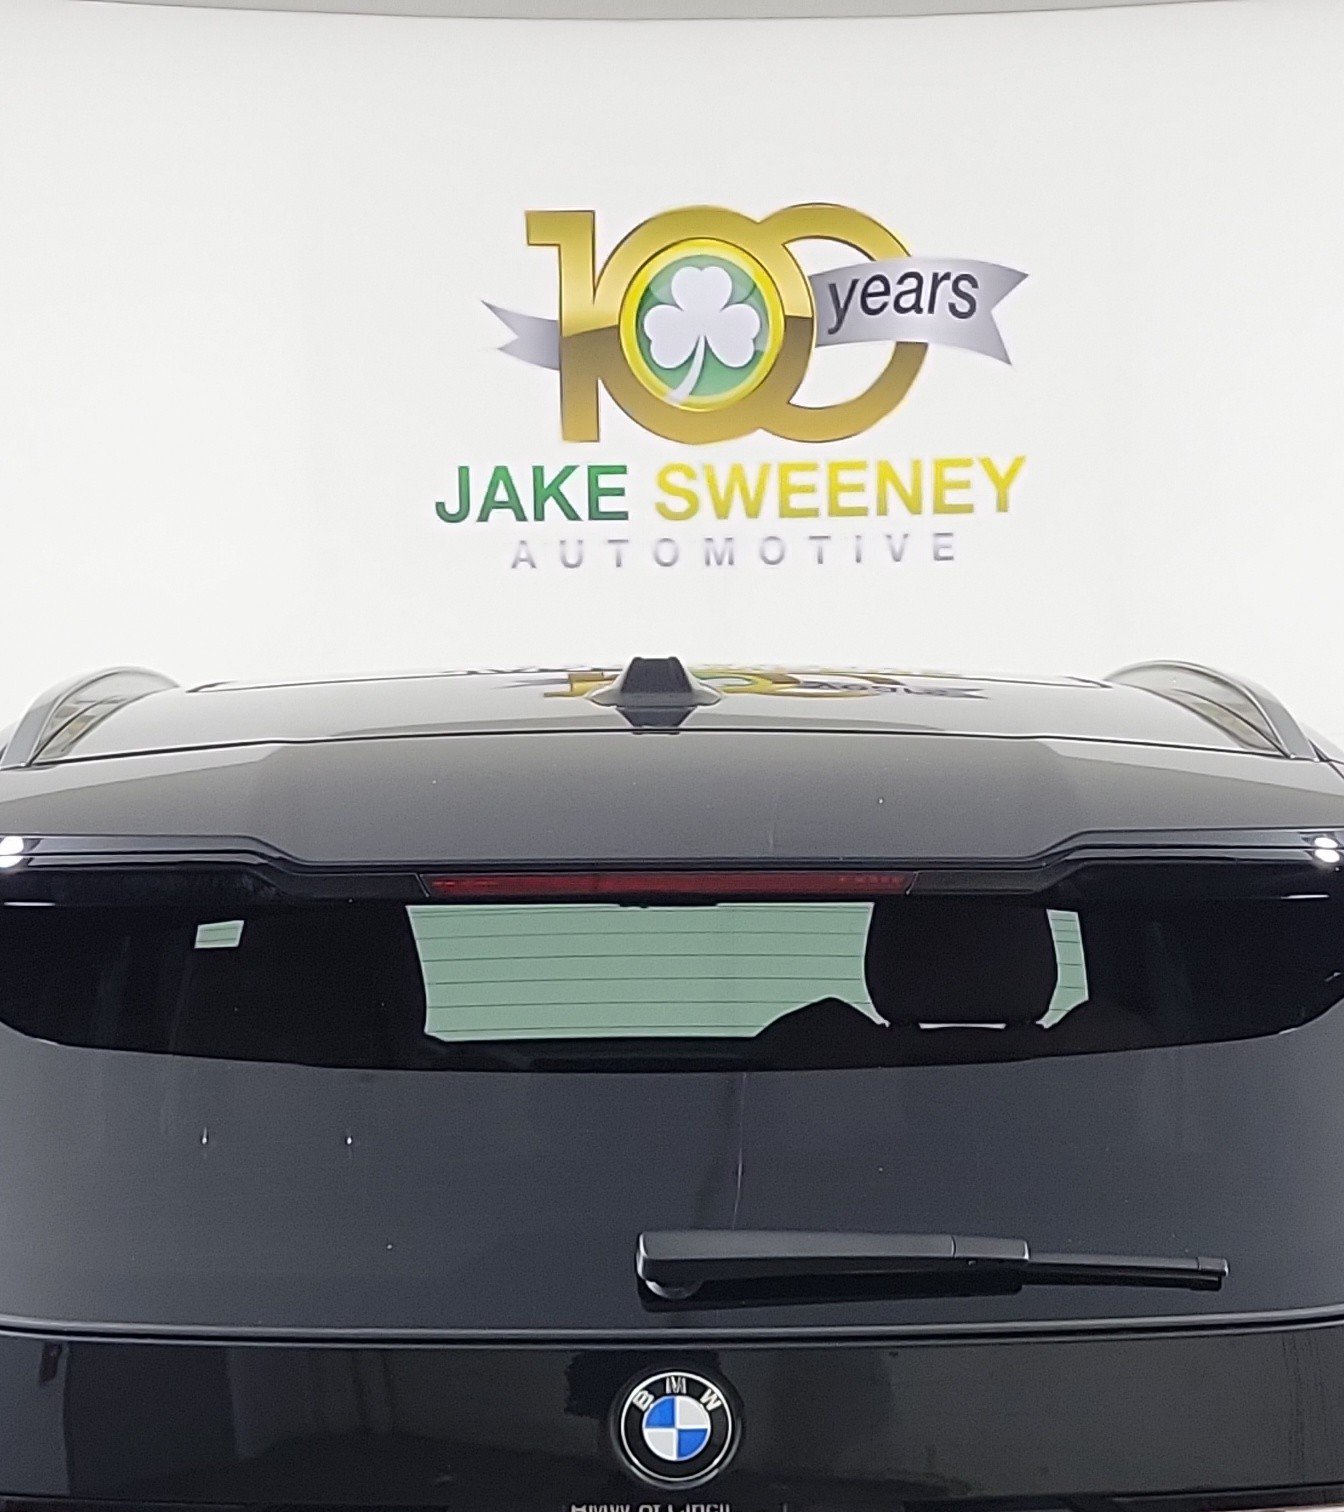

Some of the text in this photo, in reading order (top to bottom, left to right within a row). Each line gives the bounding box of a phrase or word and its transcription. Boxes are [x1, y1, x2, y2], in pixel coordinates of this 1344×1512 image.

[826, 271, 980, 334] years
[435, 456, 1027, 524] JAKE SWEENEY
[511, 532, 957, 570] AUTOMOTIVE
[632, 1375, 722, 1412] BMW
